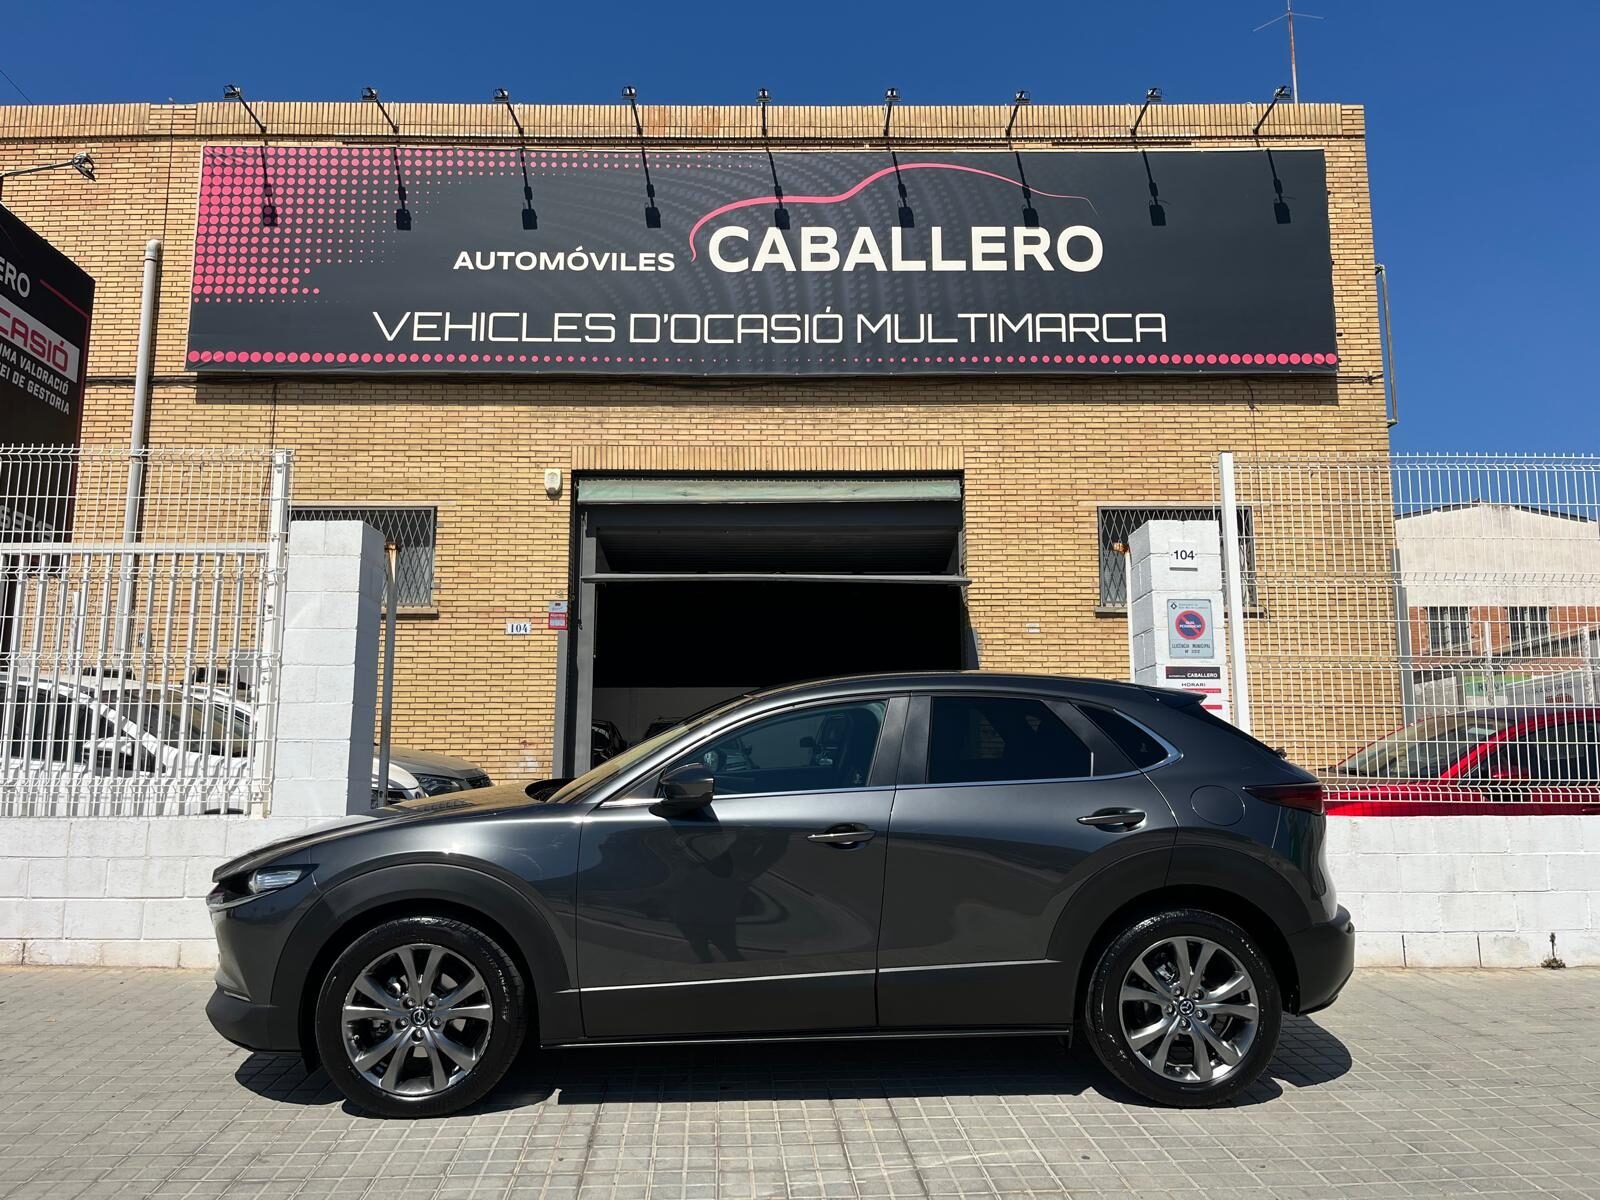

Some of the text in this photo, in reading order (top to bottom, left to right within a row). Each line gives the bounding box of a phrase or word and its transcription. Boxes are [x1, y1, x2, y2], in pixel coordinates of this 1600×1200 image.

[453, 225, 1104, 273] AUTOMÓVILES CABALLERO
[372, 306, 1168, 344] VEHICLES D'OCASIÓ MULTIMARCA
[12, 370, 26, 389] DE
[27, 380, 70, 415] GESTORIA
[20, 355, 69, 395] VALORACIÓ
[511, 623, 528, 633] 104
